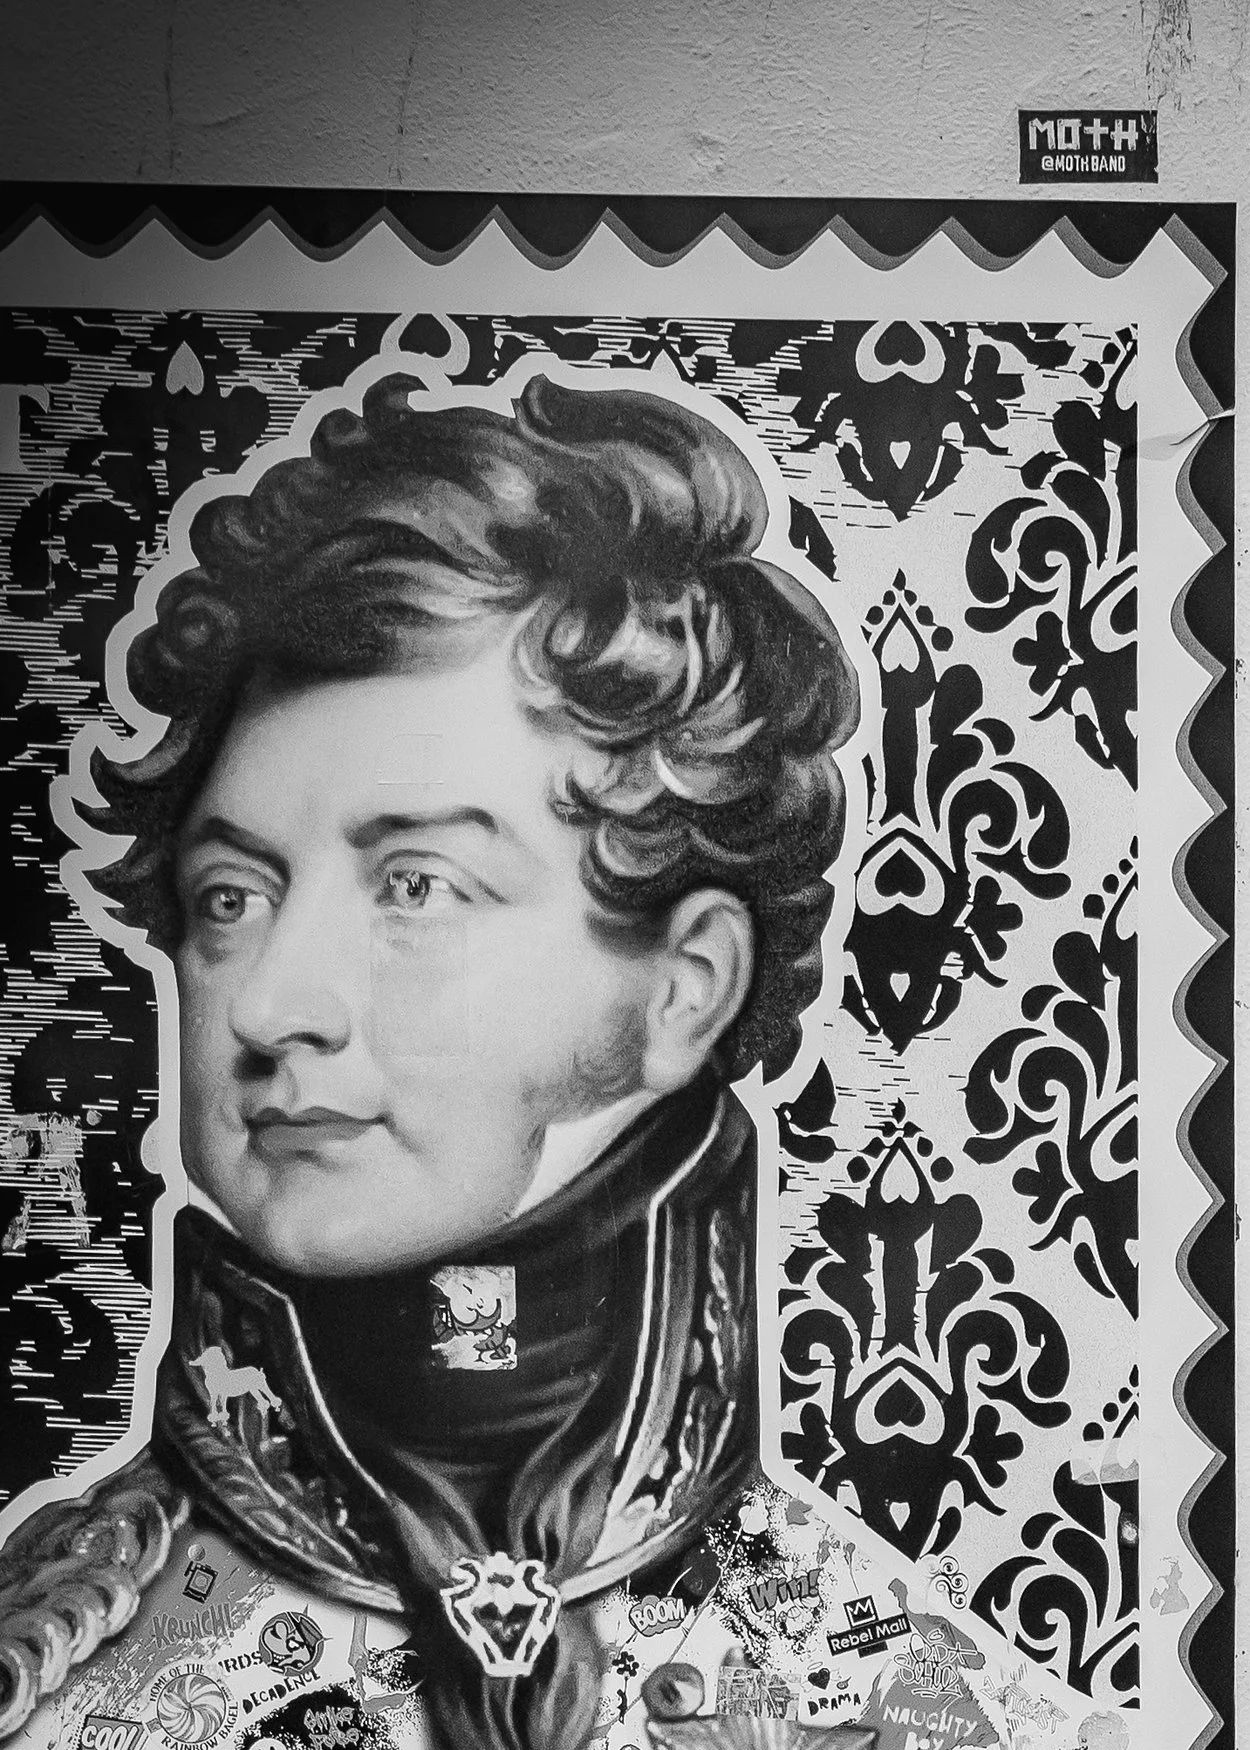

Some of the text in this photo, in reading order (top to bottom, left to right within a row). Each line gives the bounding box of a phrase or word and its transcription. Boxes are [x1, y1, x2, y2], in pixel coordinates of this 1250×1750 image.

[1028, 117, 1139, 151] MOTH
[630, 1598, 685, 1632] BOOM
[830, 1631, 874, 1652] Rebel
[149, 1674, 170, 1702] HOME
[169, 1665, 182, 1678] OF
[242, 1669, 321, 1714] DECADENCE
[218, 1701, 239, 1740] BAGEL
[808, 1692, 861, 1717] DRAMA
[883, 1704, 978, 1739] NAUGHTY
